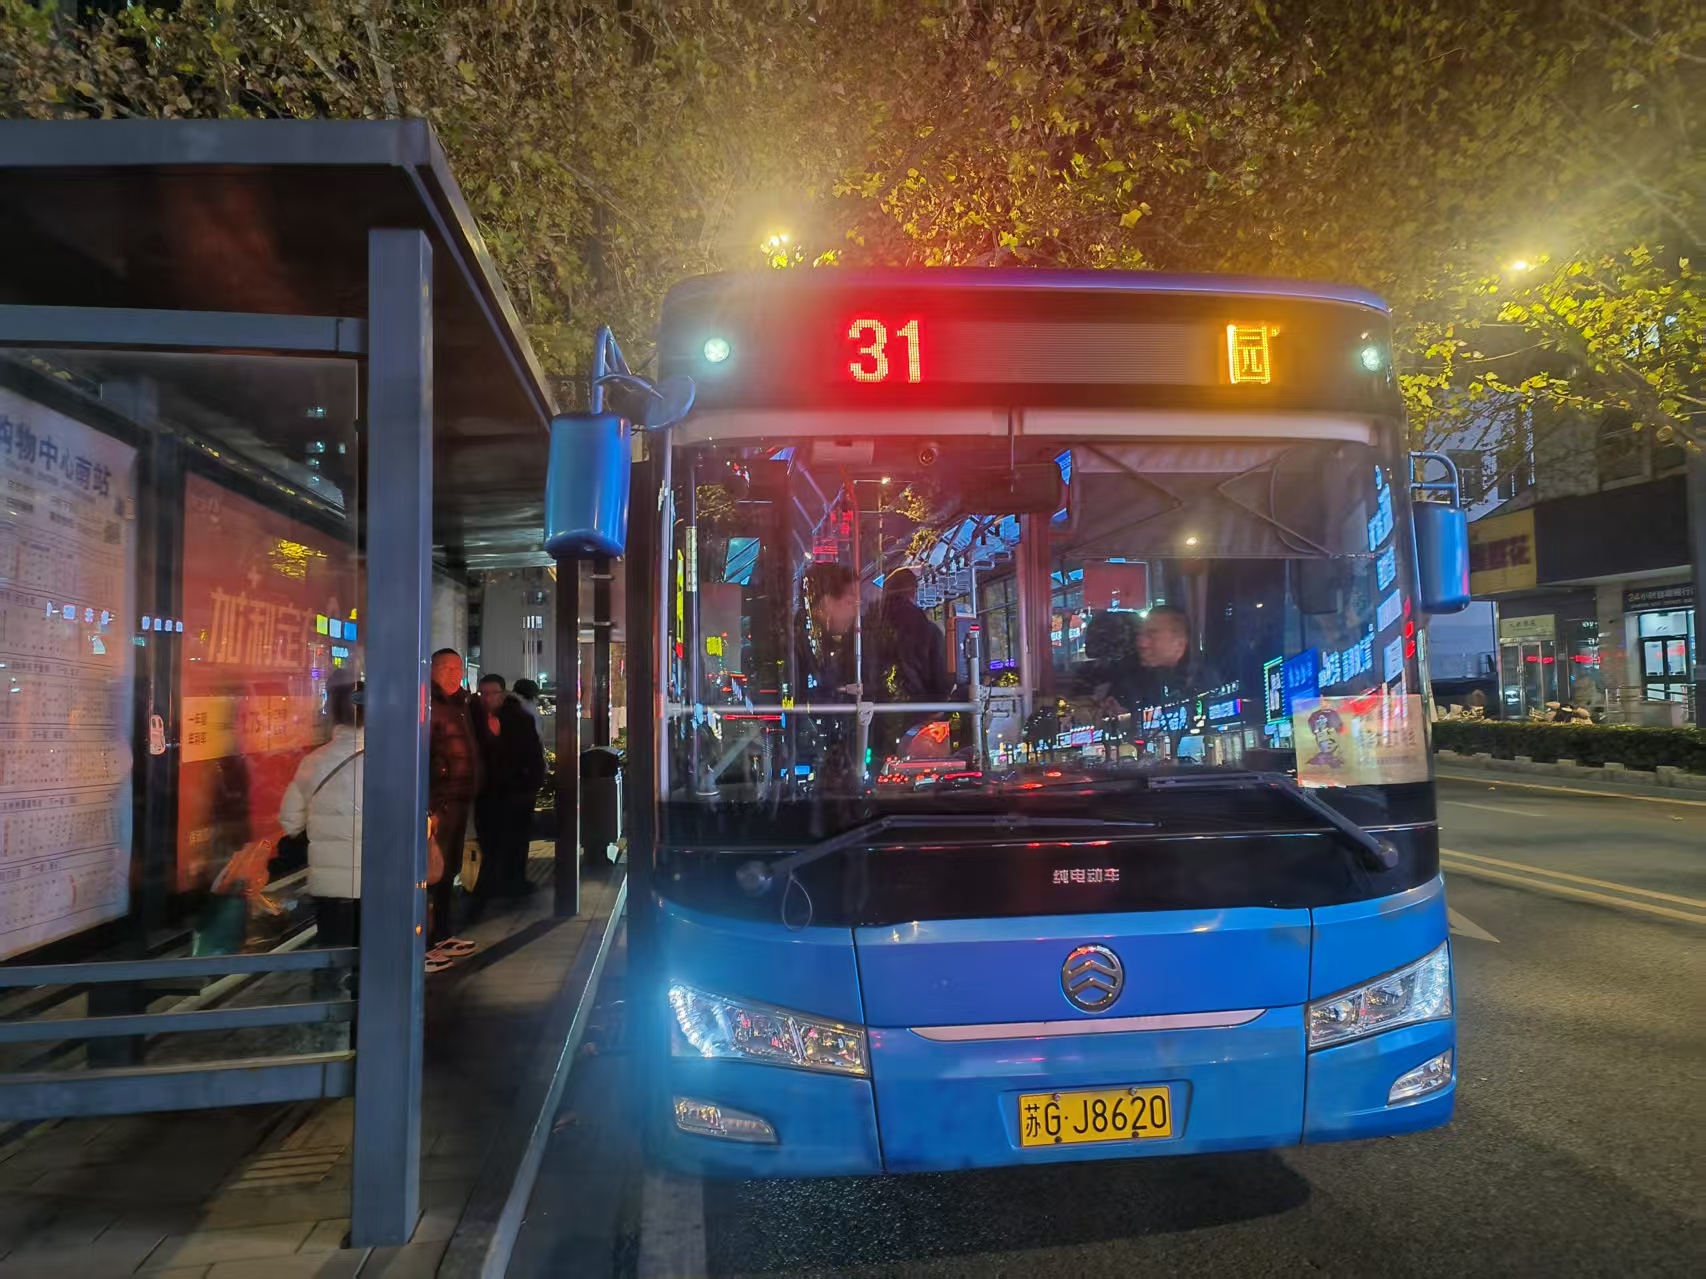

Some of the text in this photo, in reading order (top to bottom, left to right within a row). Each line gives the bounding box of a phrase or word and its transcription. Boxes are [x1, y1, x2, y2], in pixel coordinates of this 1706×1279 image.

[849, 319, 920, 383] 31
[1227, 325, 1271, 384] 园
[1053, 868, 1120, 883] 纯电动车
